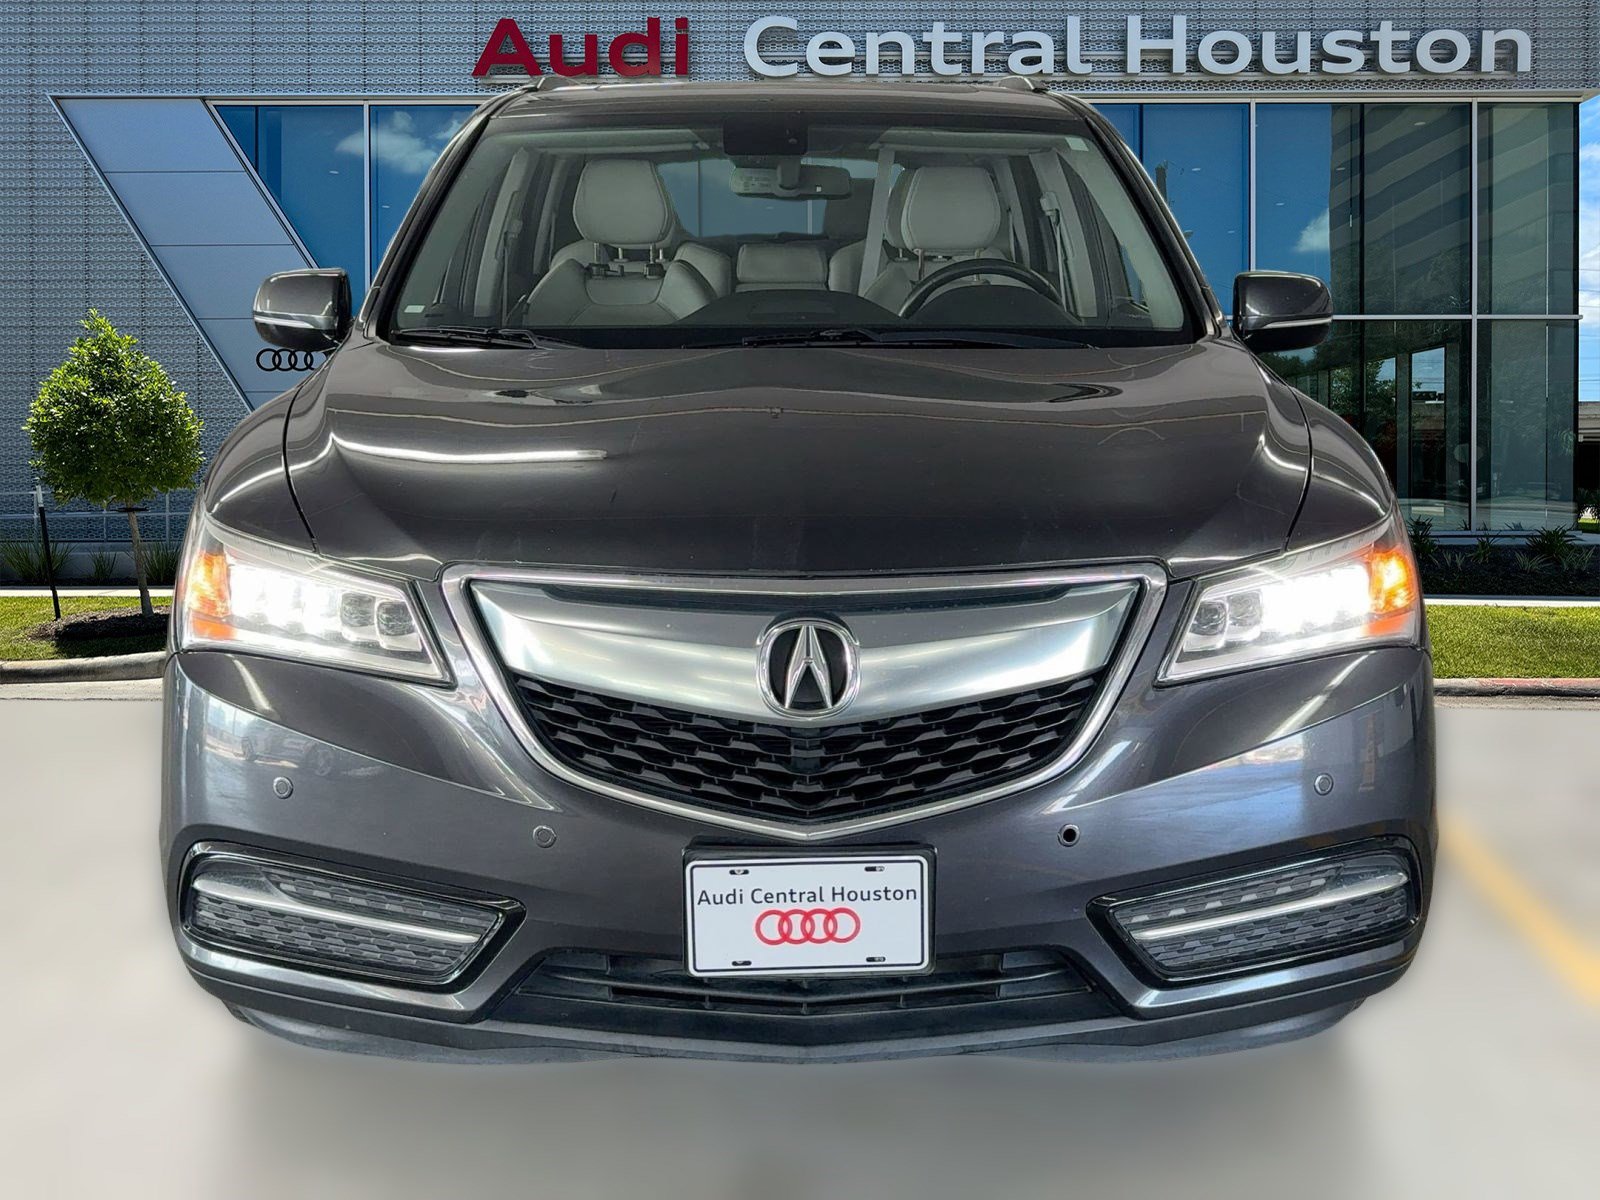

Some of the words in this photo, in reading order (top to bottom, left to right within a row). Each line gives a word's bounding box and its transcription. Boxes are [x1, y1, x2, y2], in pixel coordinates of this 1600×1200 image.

[472, 17, 690, 77] Audi
[743, 15, 1093, 77] Central
[1126, 14, 1532, 75] Houston
[697, 888, 744, 906] Audi
[750, 886, 824, 904] Central
[831, 885, 918, 903] Houston
